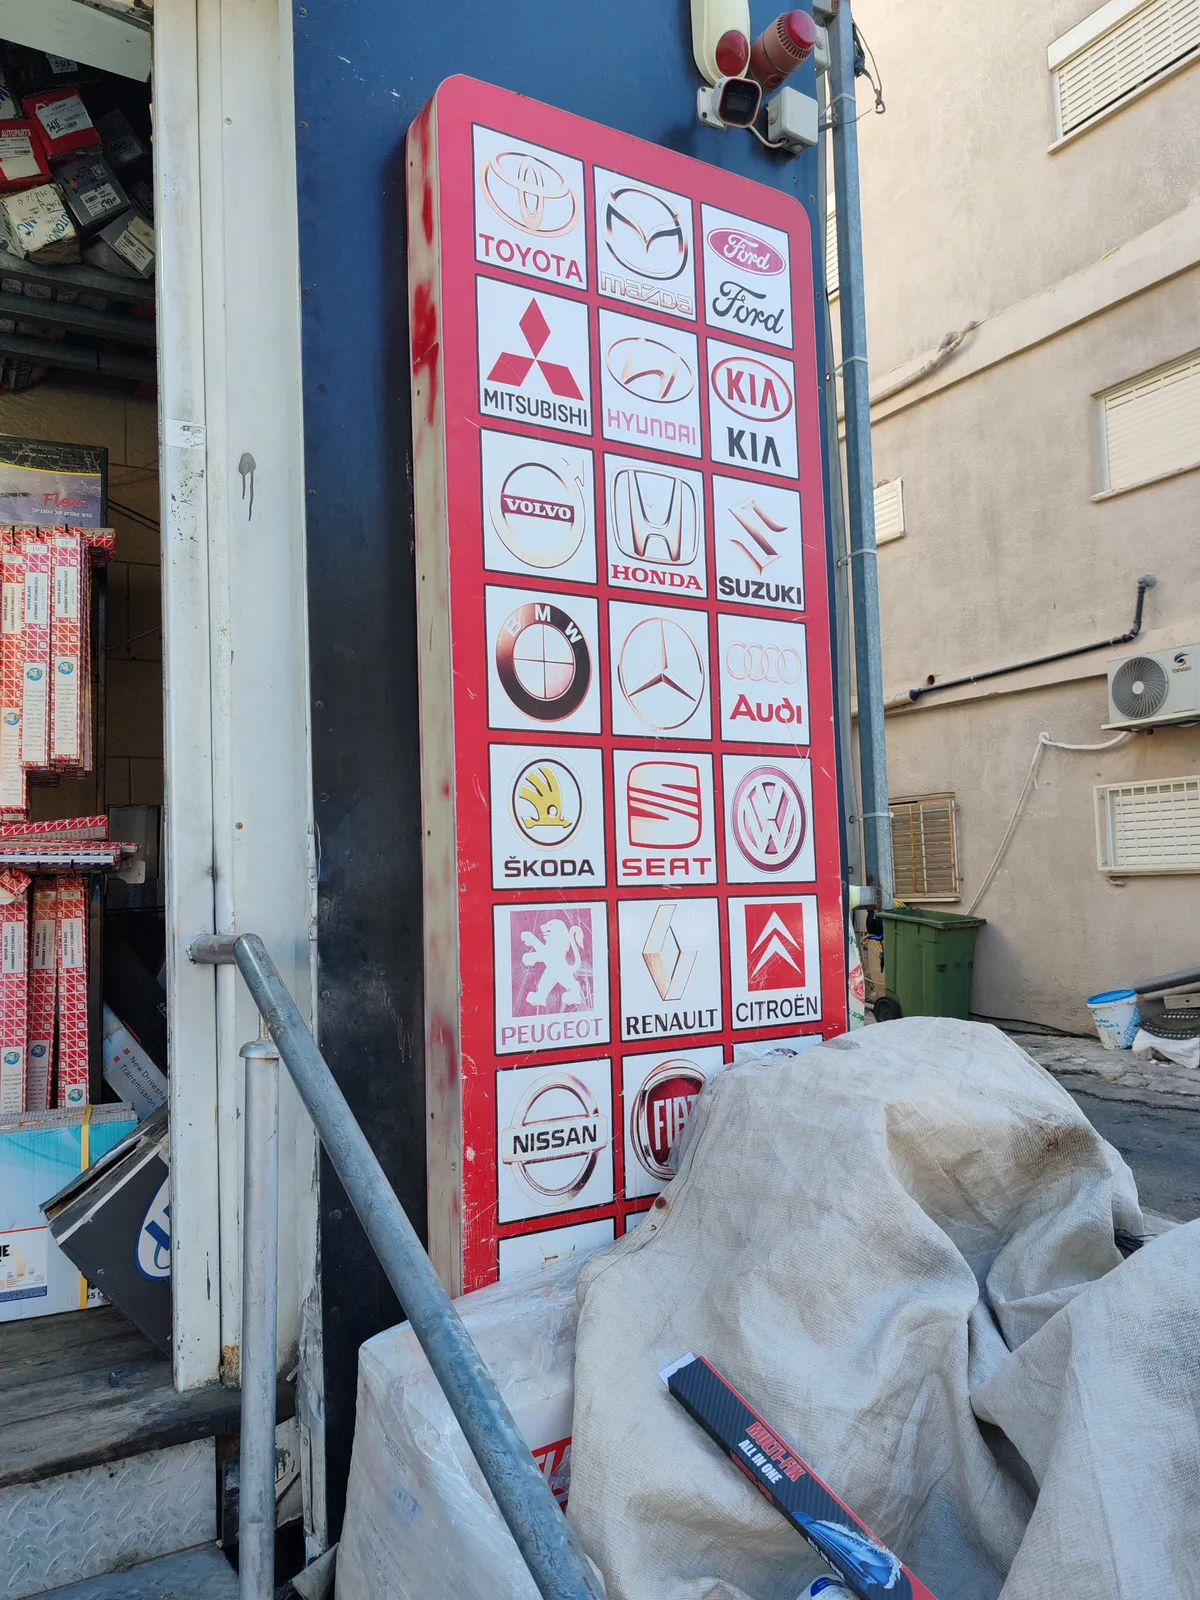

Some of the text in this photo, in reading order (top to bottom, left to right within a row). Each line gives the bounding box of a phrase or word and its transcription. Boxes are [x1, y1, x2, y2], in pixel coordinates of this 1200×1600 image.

[479, 233, 583, 283] TOYOTA
[723, 234, 770, 271] Ford
[600, 271, 694, 315] mazda
[712, 281, 784, 334] Ford
[726, 367, 780, 412] KIA
[484, 388, 587, 427] MITSUBISHI
[607, 408, 696, 445] HYUNDAI
[727, 426, 781, 467] KIA
[42, 491, 87, 508] Flex
[504, 497, 571, 520] VOLVO
[611, 564, 703, 591] HONDA
[719, 576, 802, 605] SUZUKI
[729, 693, 802, 725] Audi
[504, 856, 595, 878] ŠKODA
[622, 857, 712, 876] SEAT
[626, 1009, 718, 1035] RENAULT
[735, 994, 818, 1023] CITROËN
[501, 1018, 603, 1046] PEUGEOT
[129, 1055, 144, 1072] New
[120, 1062, 156, 1109] Transmission
[513, 1124, 597, 1154] NISSAN
[738, 1439, 757, 1457] ALL
[751, 1453, 767, 1467] IN
[761, 1463, 783, 1484] ONE
[745, 1421, 806, 1483] MULTI-FIX
